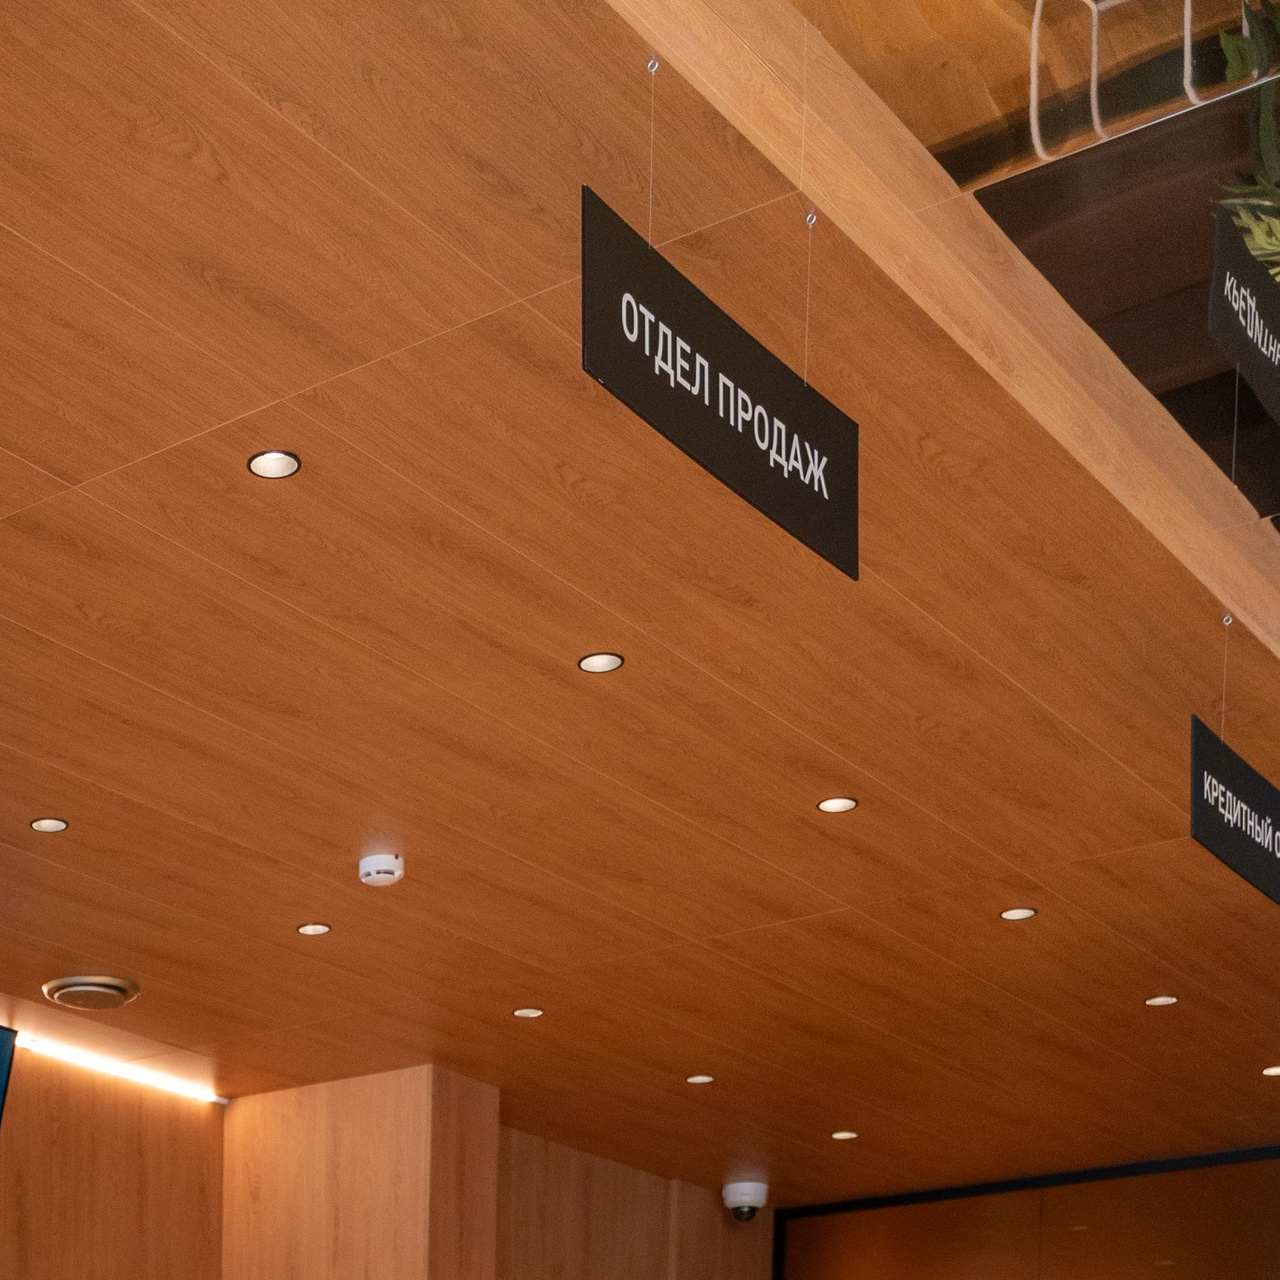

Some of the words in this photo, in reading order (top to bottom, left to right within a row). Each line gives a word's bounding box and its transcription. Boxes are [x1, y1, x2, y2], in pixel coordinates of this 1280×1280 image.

[621, 292, 709, 406] ОТДЕЛ
[719, 372, 829, 500] ПРОДАЖ
[1203, 770, 1273, 852] КРЕДИТНЫЙ
